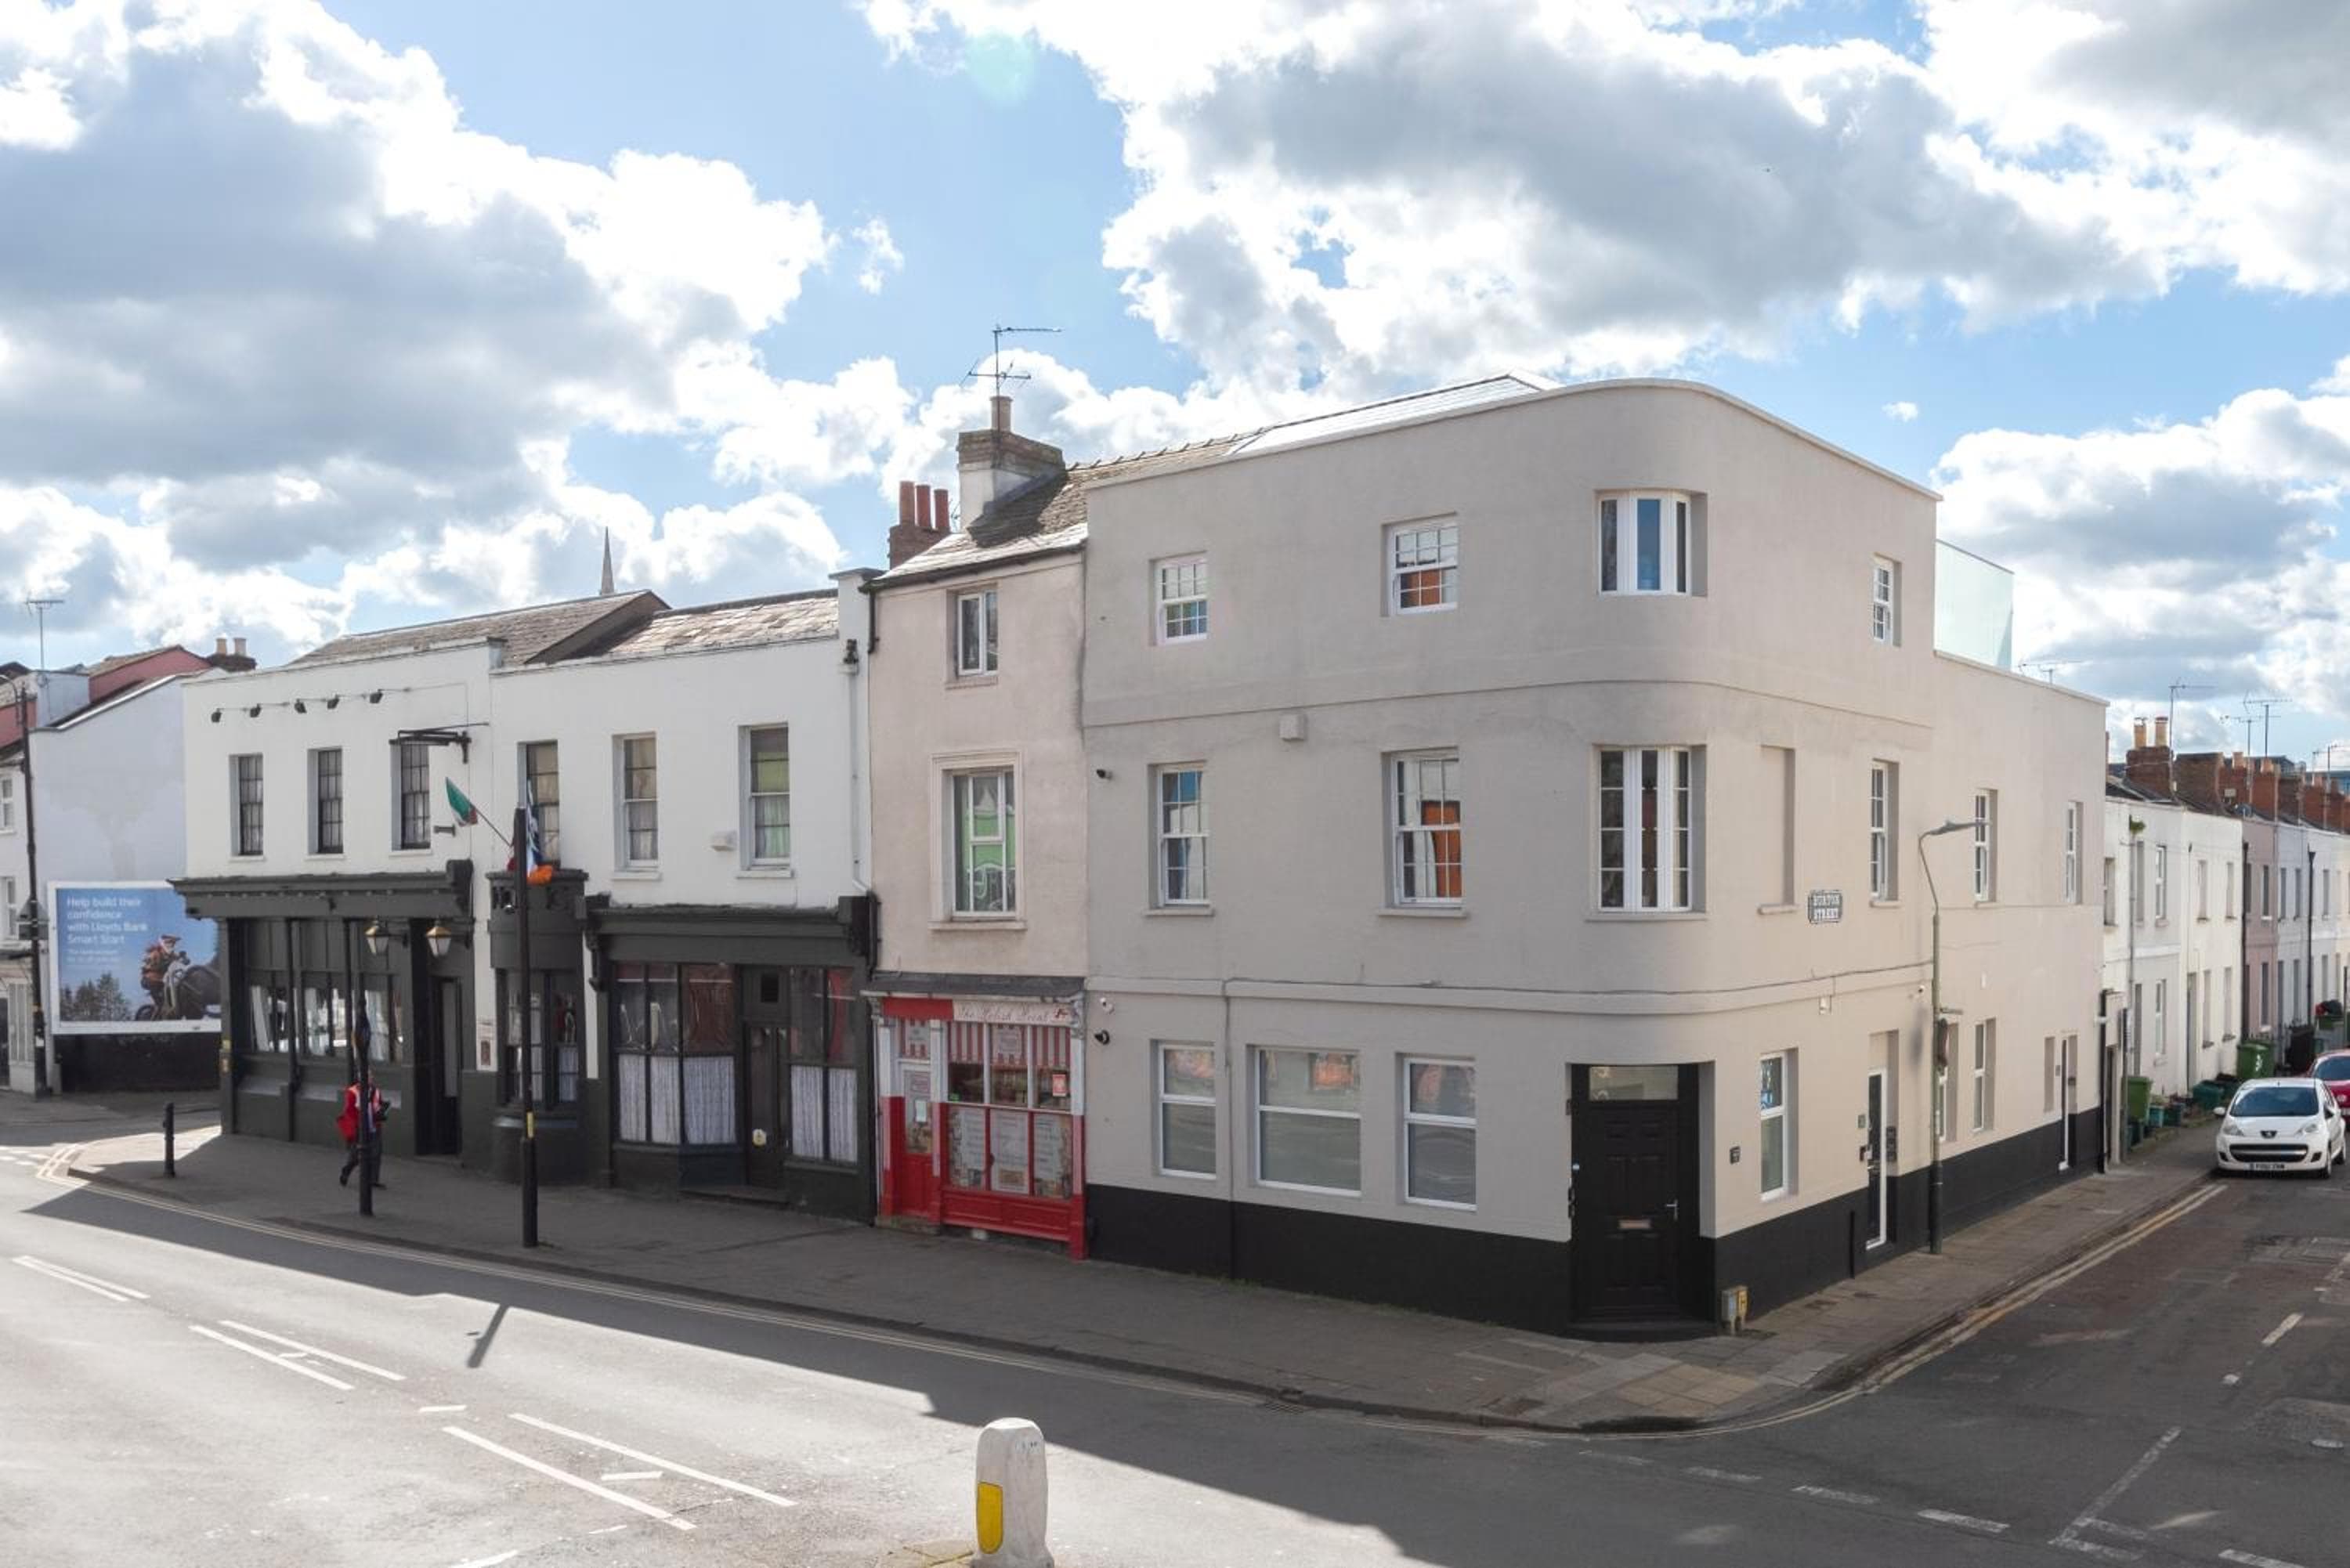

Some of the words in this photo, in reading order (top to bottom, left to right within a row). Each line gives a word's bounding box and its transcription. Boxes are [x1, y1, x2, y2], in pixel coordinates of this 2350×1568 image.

[67, 896, 89, 909] Help
[92, 896, 117, 907] build
[119, 897, 140, 906] their
[67, 910, 122, 919] confidence
[67, 923, 89, 931] with
[91, 922, 121, 934] Lloyds
[124, 922, 147, 931] Bank
[67, 934, 97, 944] Smart
[100, 934, 125, 944] Start
